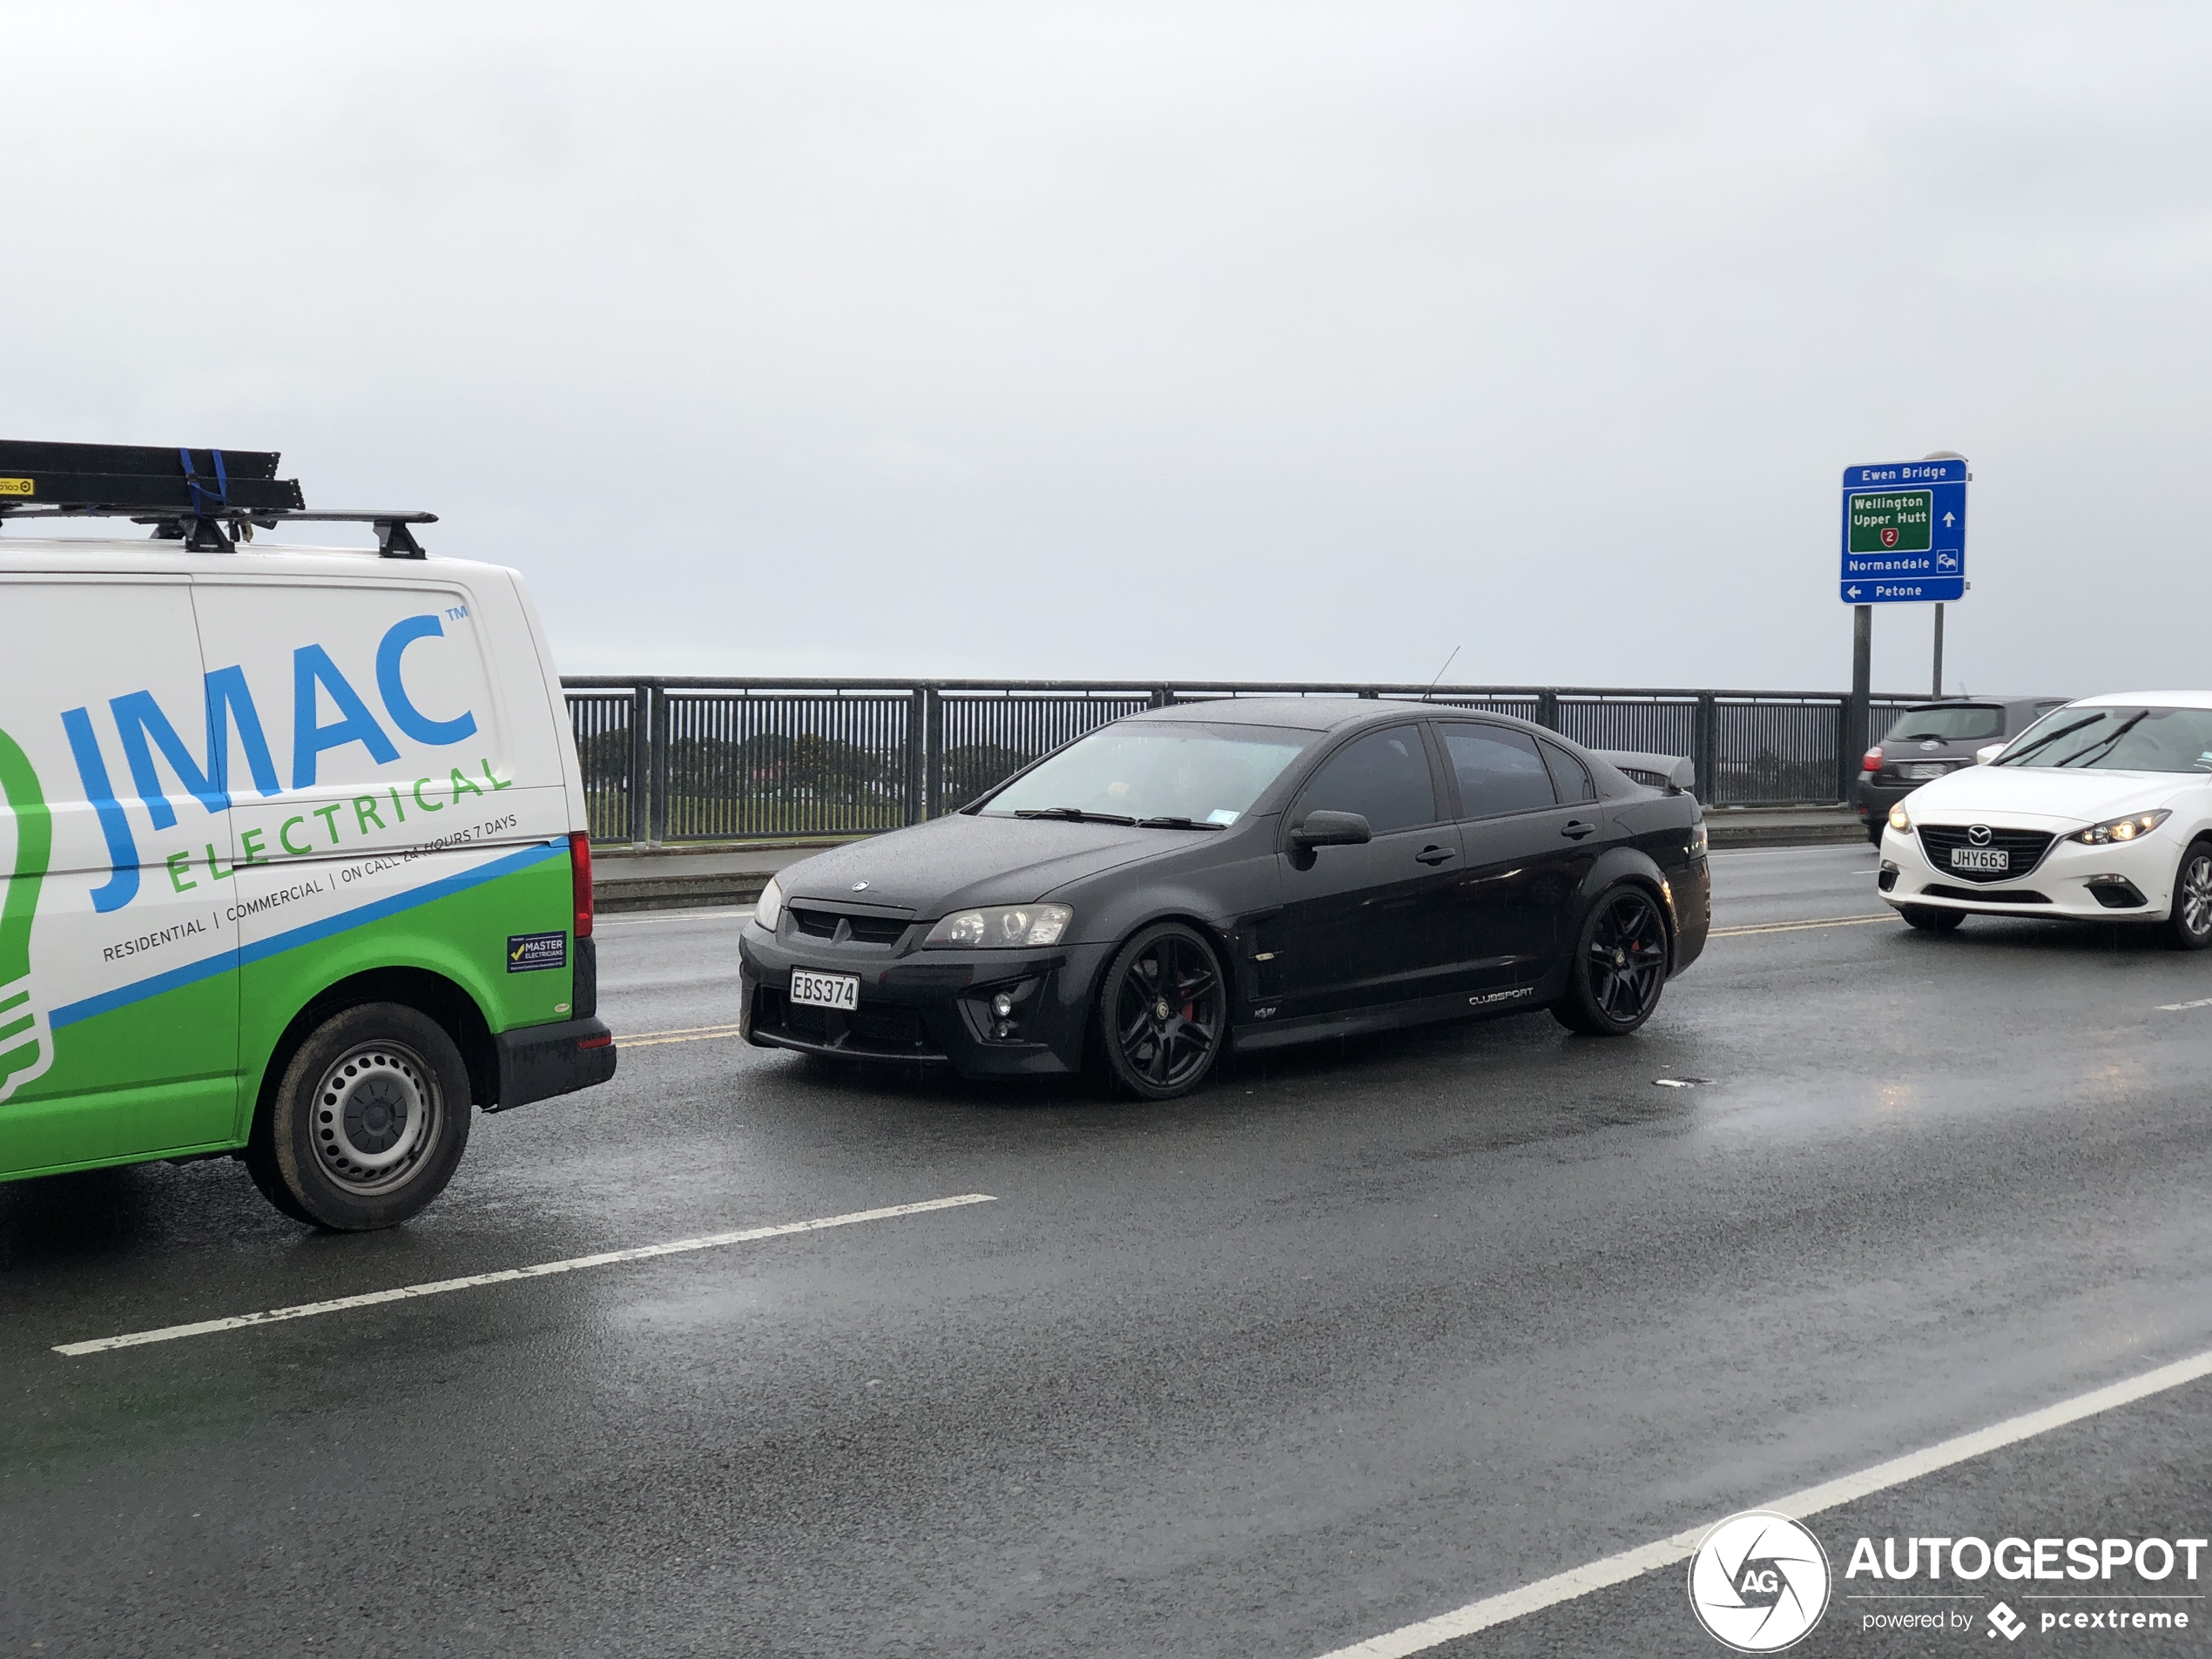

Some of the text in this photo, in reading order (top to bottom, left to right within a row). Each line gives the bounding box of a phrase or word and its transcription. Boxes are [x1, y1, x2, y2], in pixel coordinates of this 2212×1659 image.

[1862, 466, 1946, 481] Ewen Bridge
[1854, 496, 1924, 511] Wellington
[1853, 511, 1927, 528] Upper Hutt
[1885, 531, 1894, 543] 2
[1849, 558, 1931, 571] Normandale
[1875, 585, 1923, 597] Petone
[60, 614, 478, 914] JMAC
[165, 758, 512, 894] ELECTRICAL
[1953, 850, 2006, 867] JHY663
[103, 919, 206, 962] RESIDENTIAL
[226, 879, 324, 921] COMMERCIAL
[341, 866, 362, 883] ON
[364, 857, 401, 875] CALL
[422, 829, 472, 856] HOURS
[473, 826, 481, 839] 7
[485, 813, 517, 835] DAYS
[525, 940, 563, 952] MASTER
[525, 949, 563, 959] ELECTRICIANS
[792, 975, 854, 1006] EBS374
[1468, 987, 1534, 1006] CLUBSPORT
